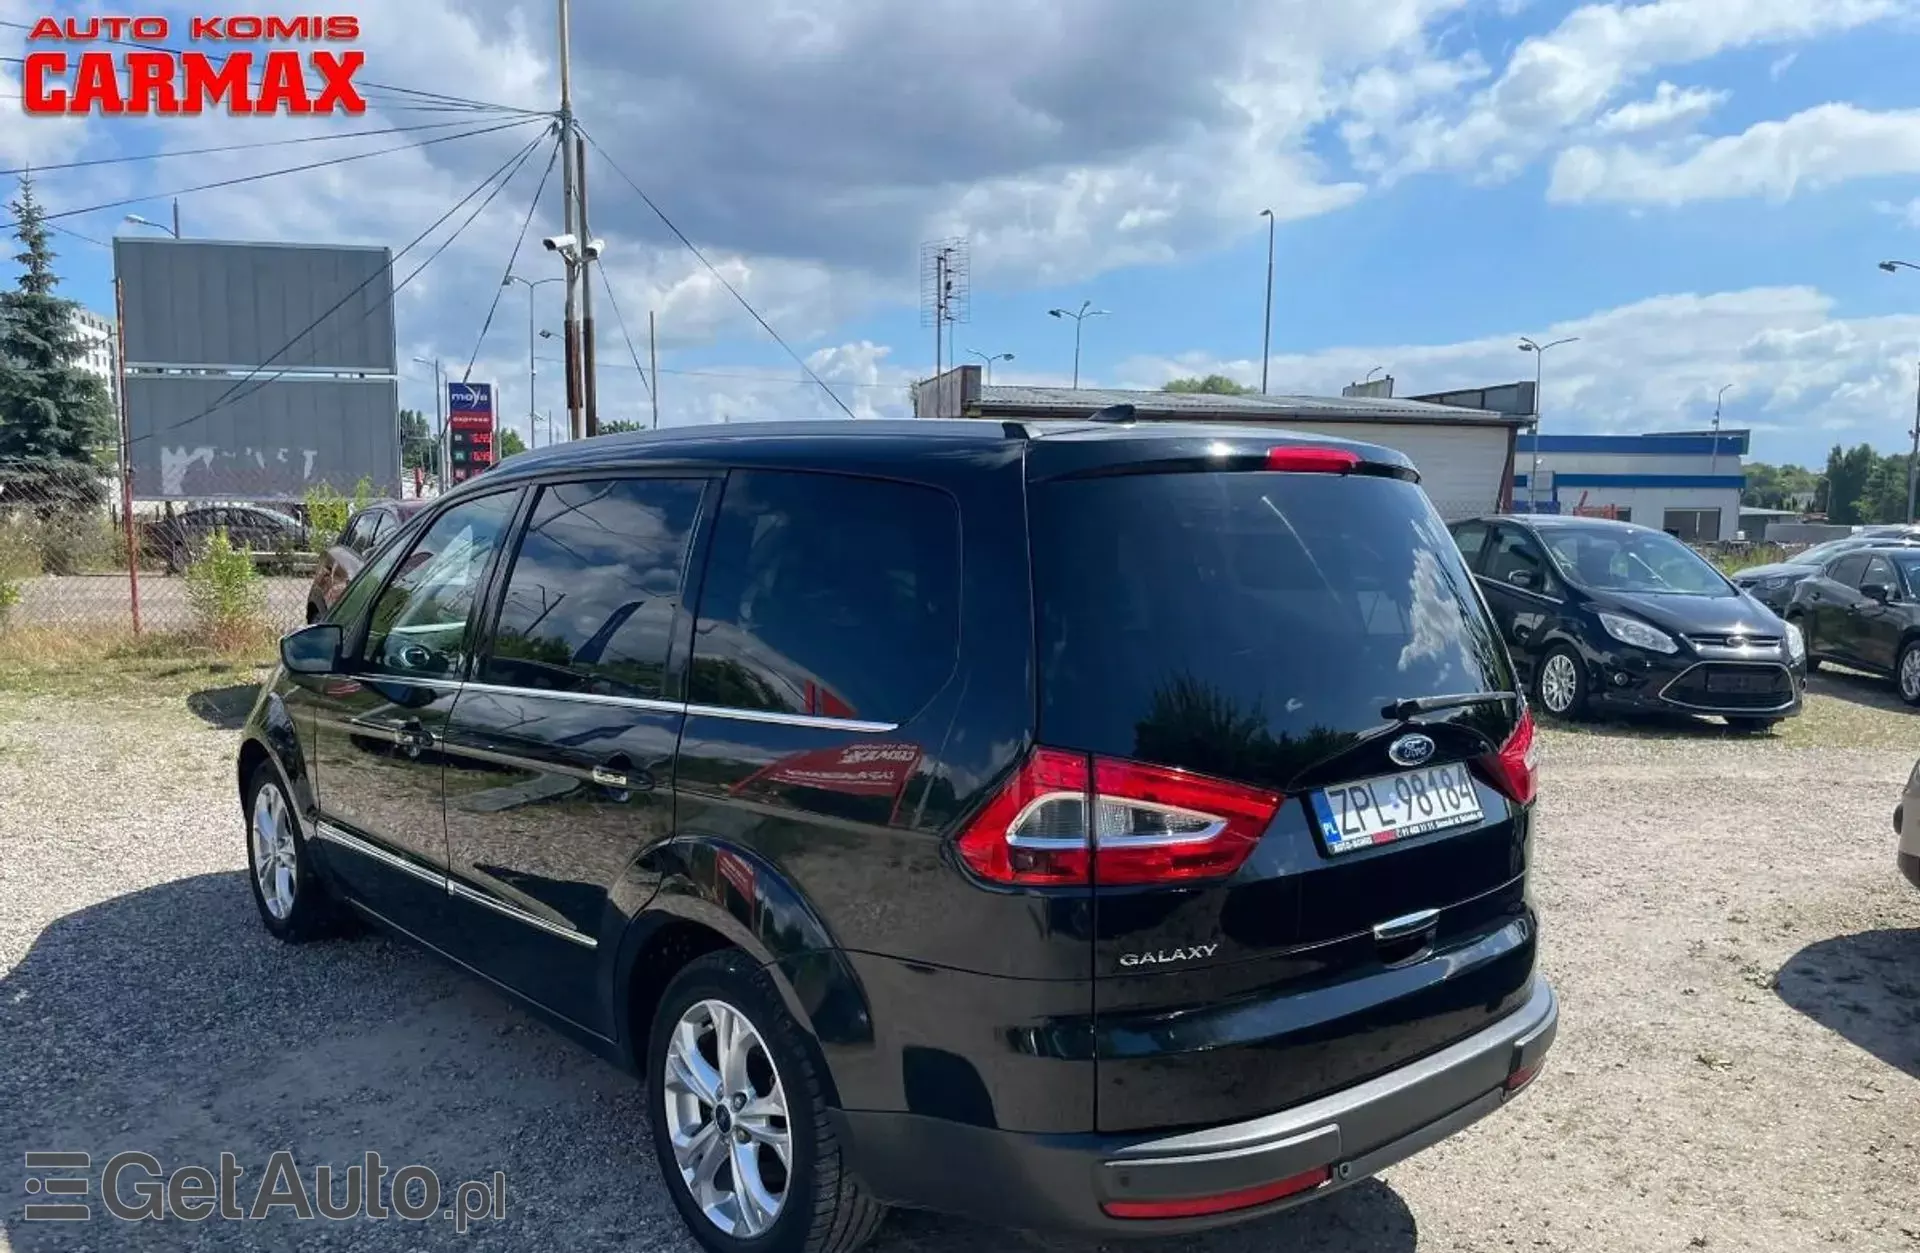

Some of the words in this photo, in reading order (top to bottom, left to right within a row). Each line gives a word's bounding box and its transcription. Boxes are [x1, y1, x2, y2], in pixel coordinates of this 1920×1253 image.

[451, 386, 488, 409] moya
[1328, 782, 1396, 836] ZPL
[1394, 765, 1476, 821] 98184
[1323, 822, 1338, 837] PL
[1120, 943, 1218, 966] GALAXY
